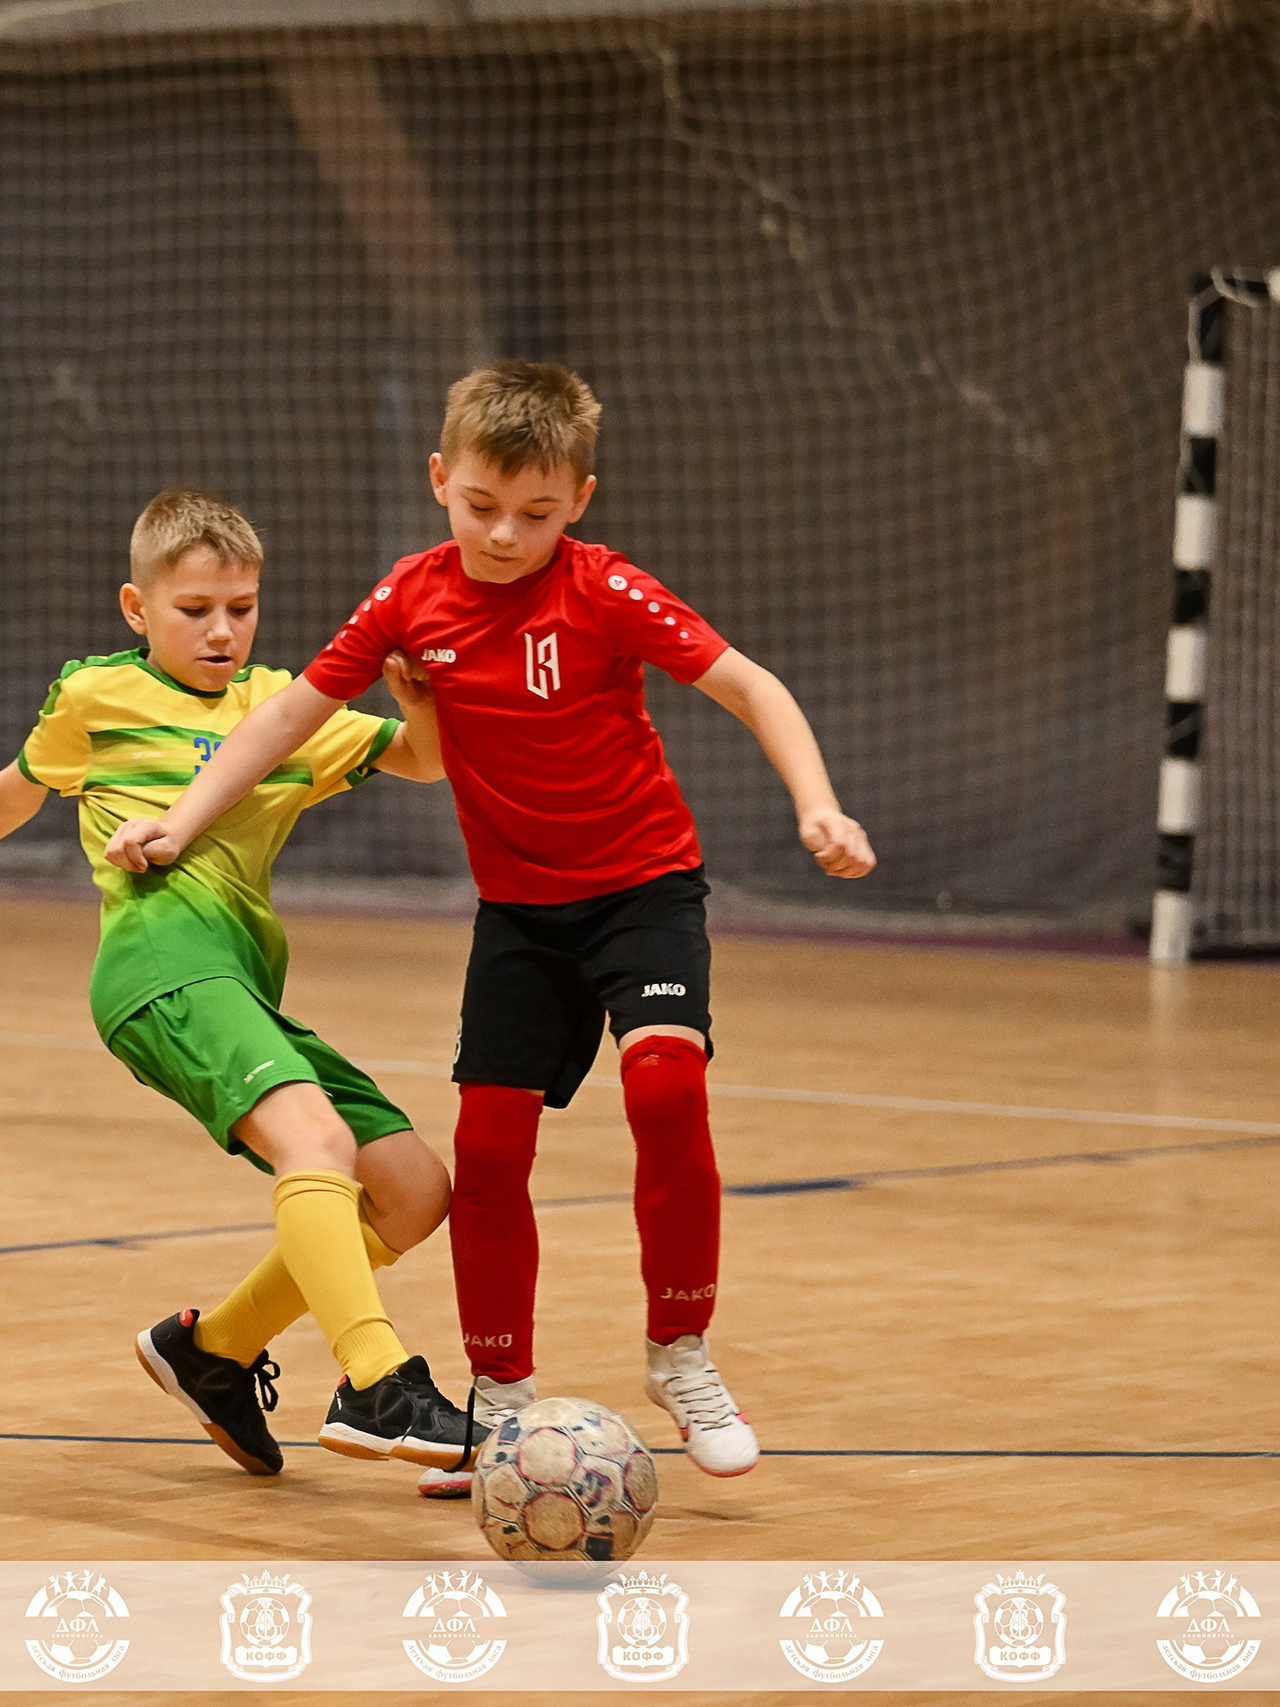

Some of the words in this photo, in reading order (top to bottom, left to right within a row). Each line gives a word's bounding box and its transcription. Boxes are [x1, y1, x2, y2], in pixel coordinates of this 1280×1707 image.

[422, 648, 456, 663] JAKO
[641, 983, 686, 998] JAKO
[660, 1283, 716, 1302] JAKO
[463, 1332, 513, 1348] JAKO
